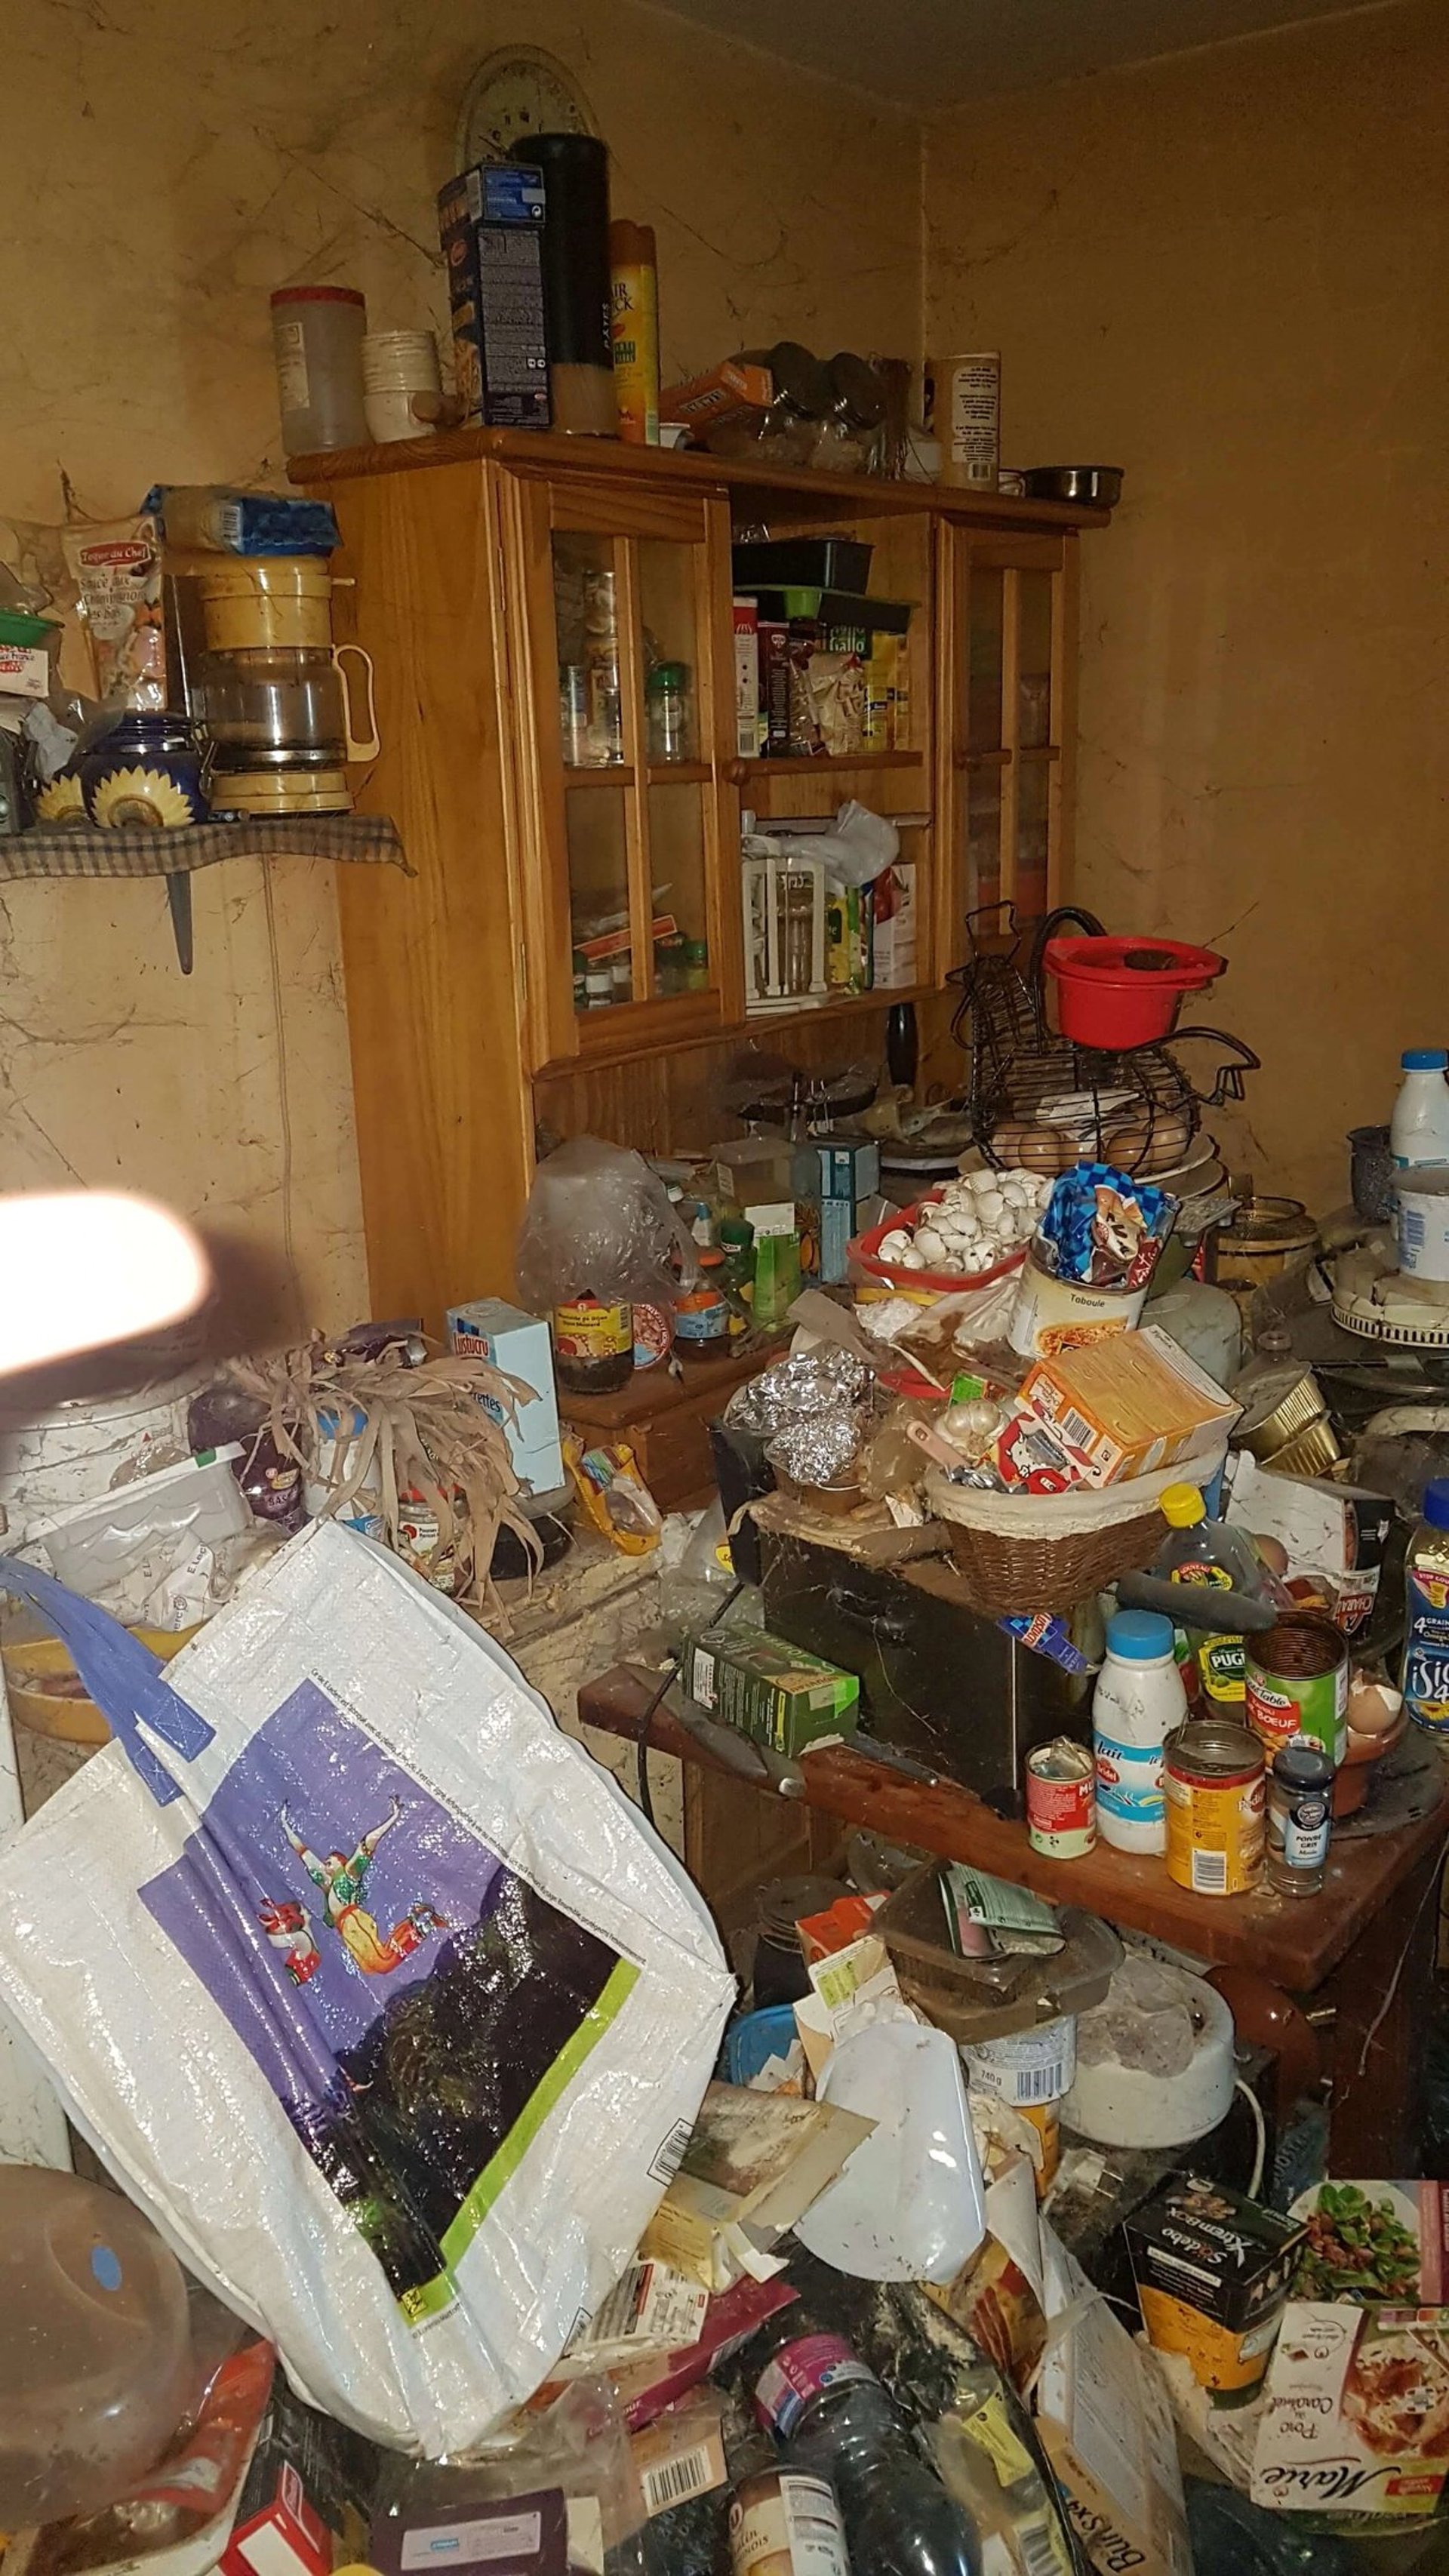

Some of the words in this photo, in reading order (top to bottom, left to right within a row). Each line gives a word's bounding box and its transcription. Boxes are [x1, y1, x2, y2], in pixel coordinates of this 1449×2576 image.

[125, 546, 146, 559] Chef
[454, 1333, 489, 1356] Lustucru
[1426, 1617, 1449, 1627] GRAIN
[1258, 1689, 1286, 1707] Table
[1257, 1709, 1297, 1728] BOEUF
[1097, 1740, 1123, 1761] lait
[1296, 1833, 1322, 1842] POIVRE
[1162, 2227, 1228, 2264] Sodebo
[1258, 2466, 1401, 2500] Marie
